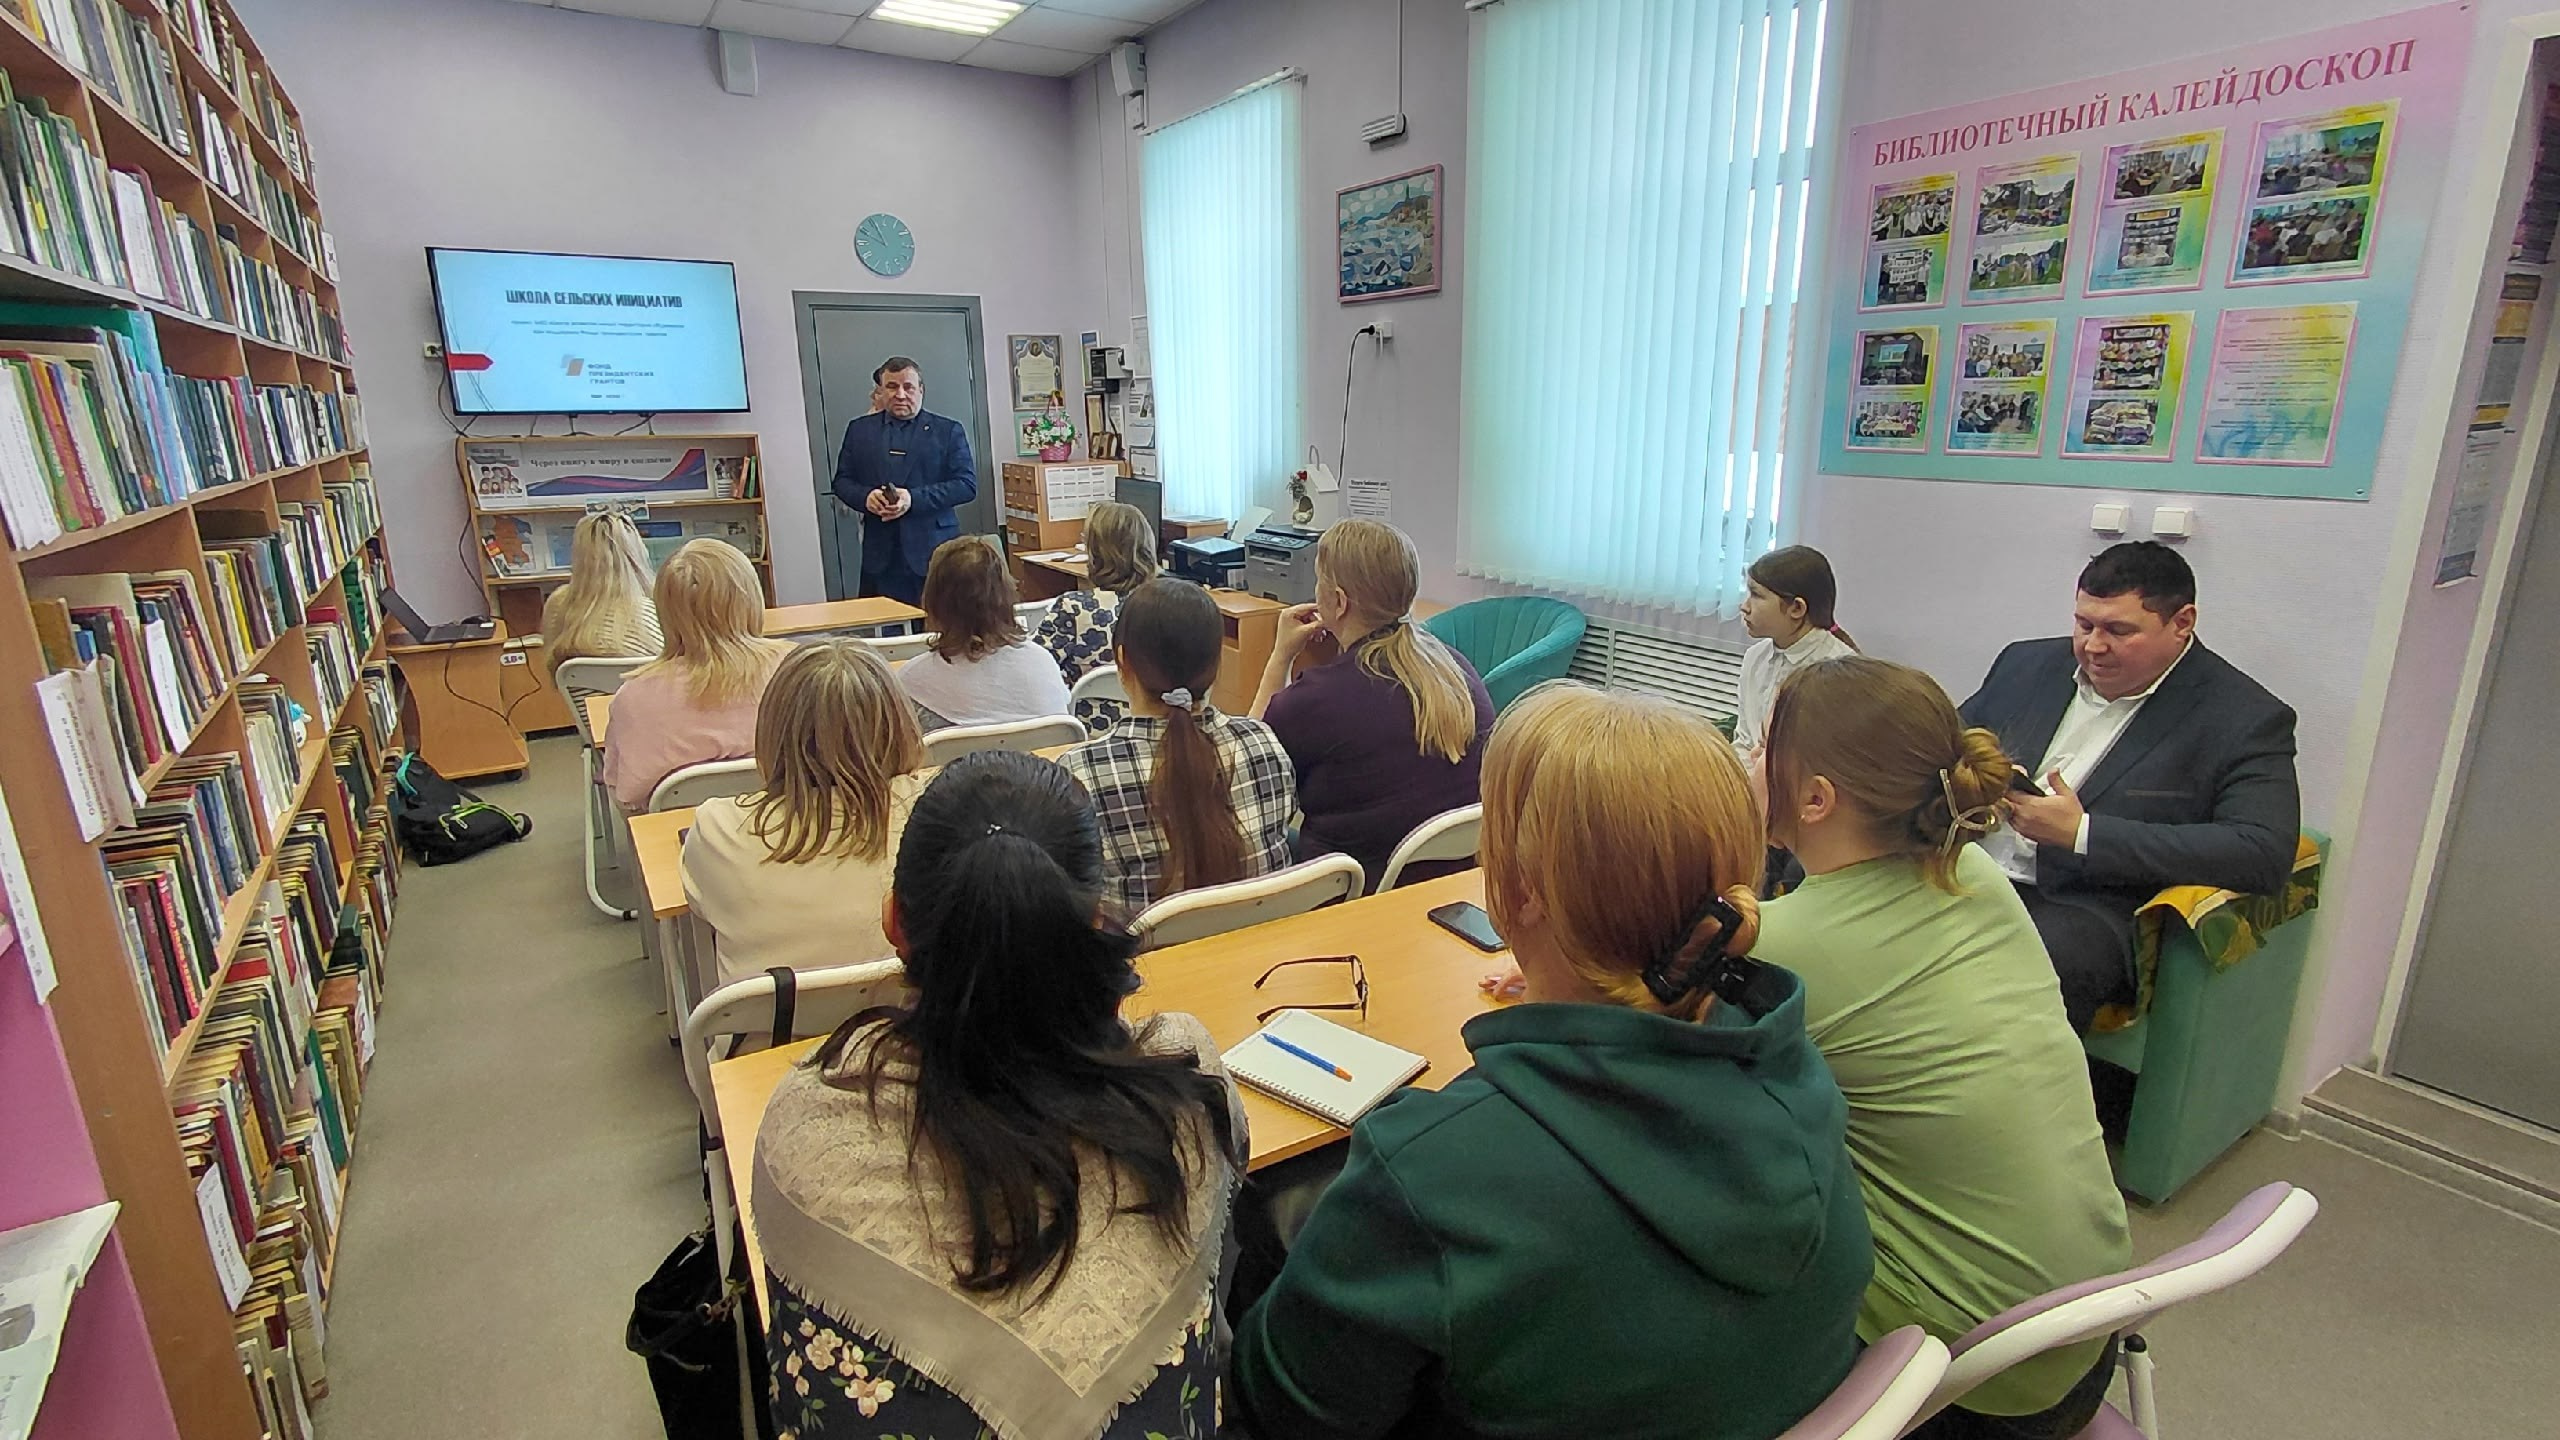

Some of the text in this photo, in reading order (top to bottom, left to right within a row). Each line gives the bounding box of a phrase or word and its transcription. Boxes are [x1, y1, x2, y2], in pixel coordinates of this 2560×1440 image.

[1872, 38, 2417, 167] БИБЛИОТЕЧНЫЙ КАЛЕЙДОСКОП
[505, 289, 683, 309] ШКОЛА СЕЛЬСКИХ ИНИЦИАТИВ
